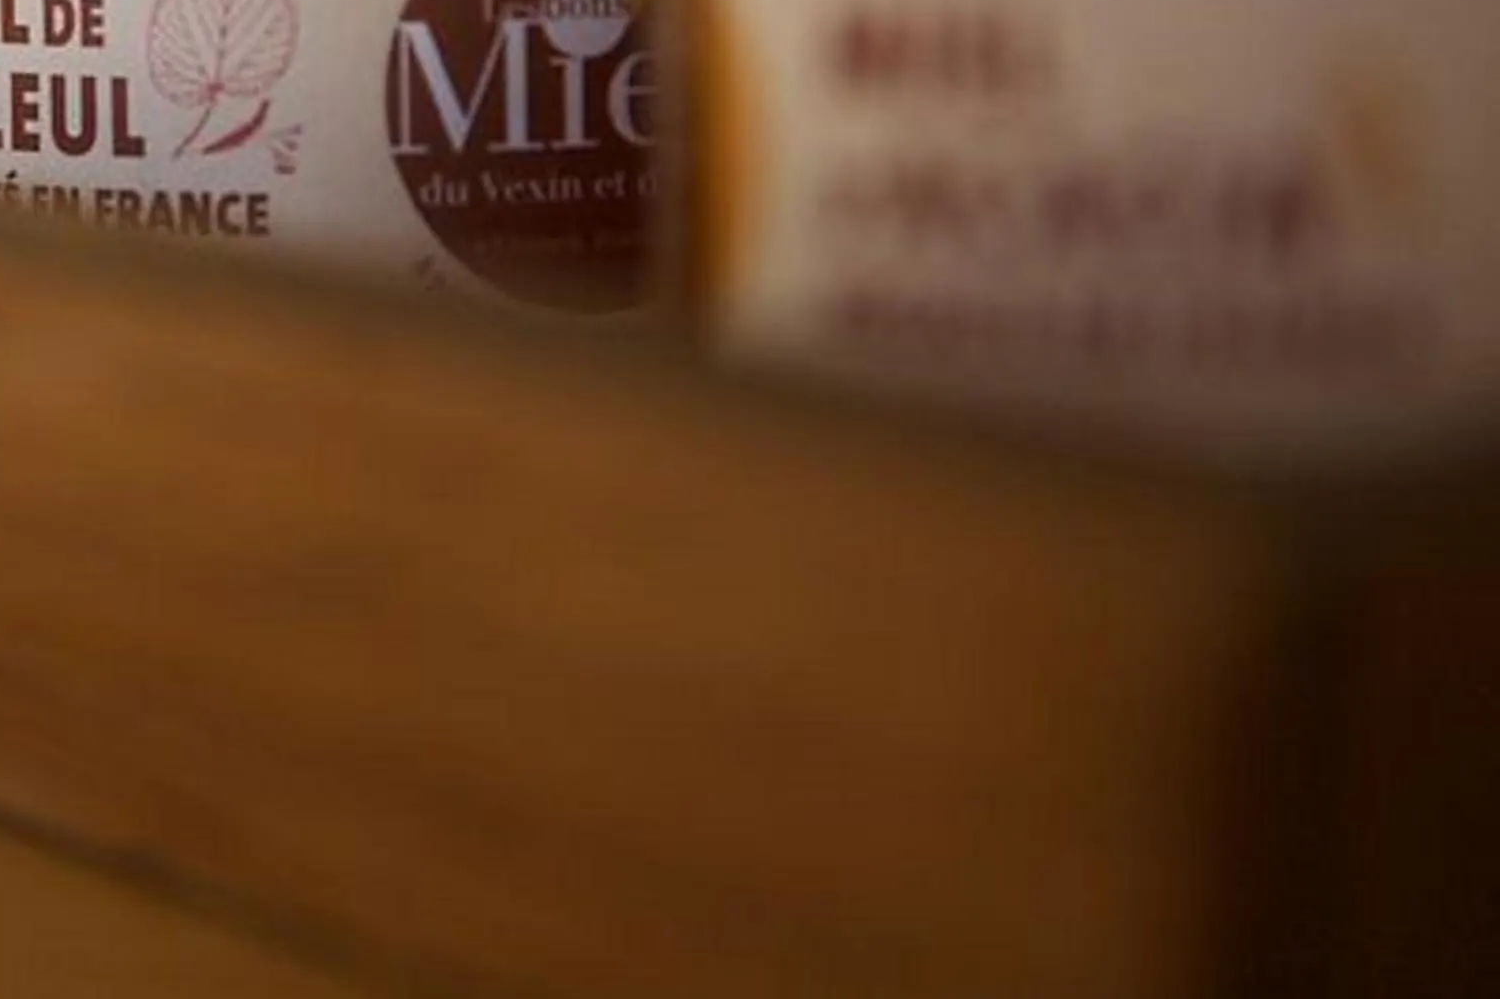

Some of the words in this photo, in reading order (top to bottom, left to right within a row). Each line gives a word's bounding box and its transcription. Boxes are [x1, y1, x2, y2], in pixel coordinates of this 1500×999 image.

[419, 172, 470, 206] du
[479, 168, 584, 202] Vexin
[593, 170, 628, 199] et
[94, 187, 270, 237] FRANCE
